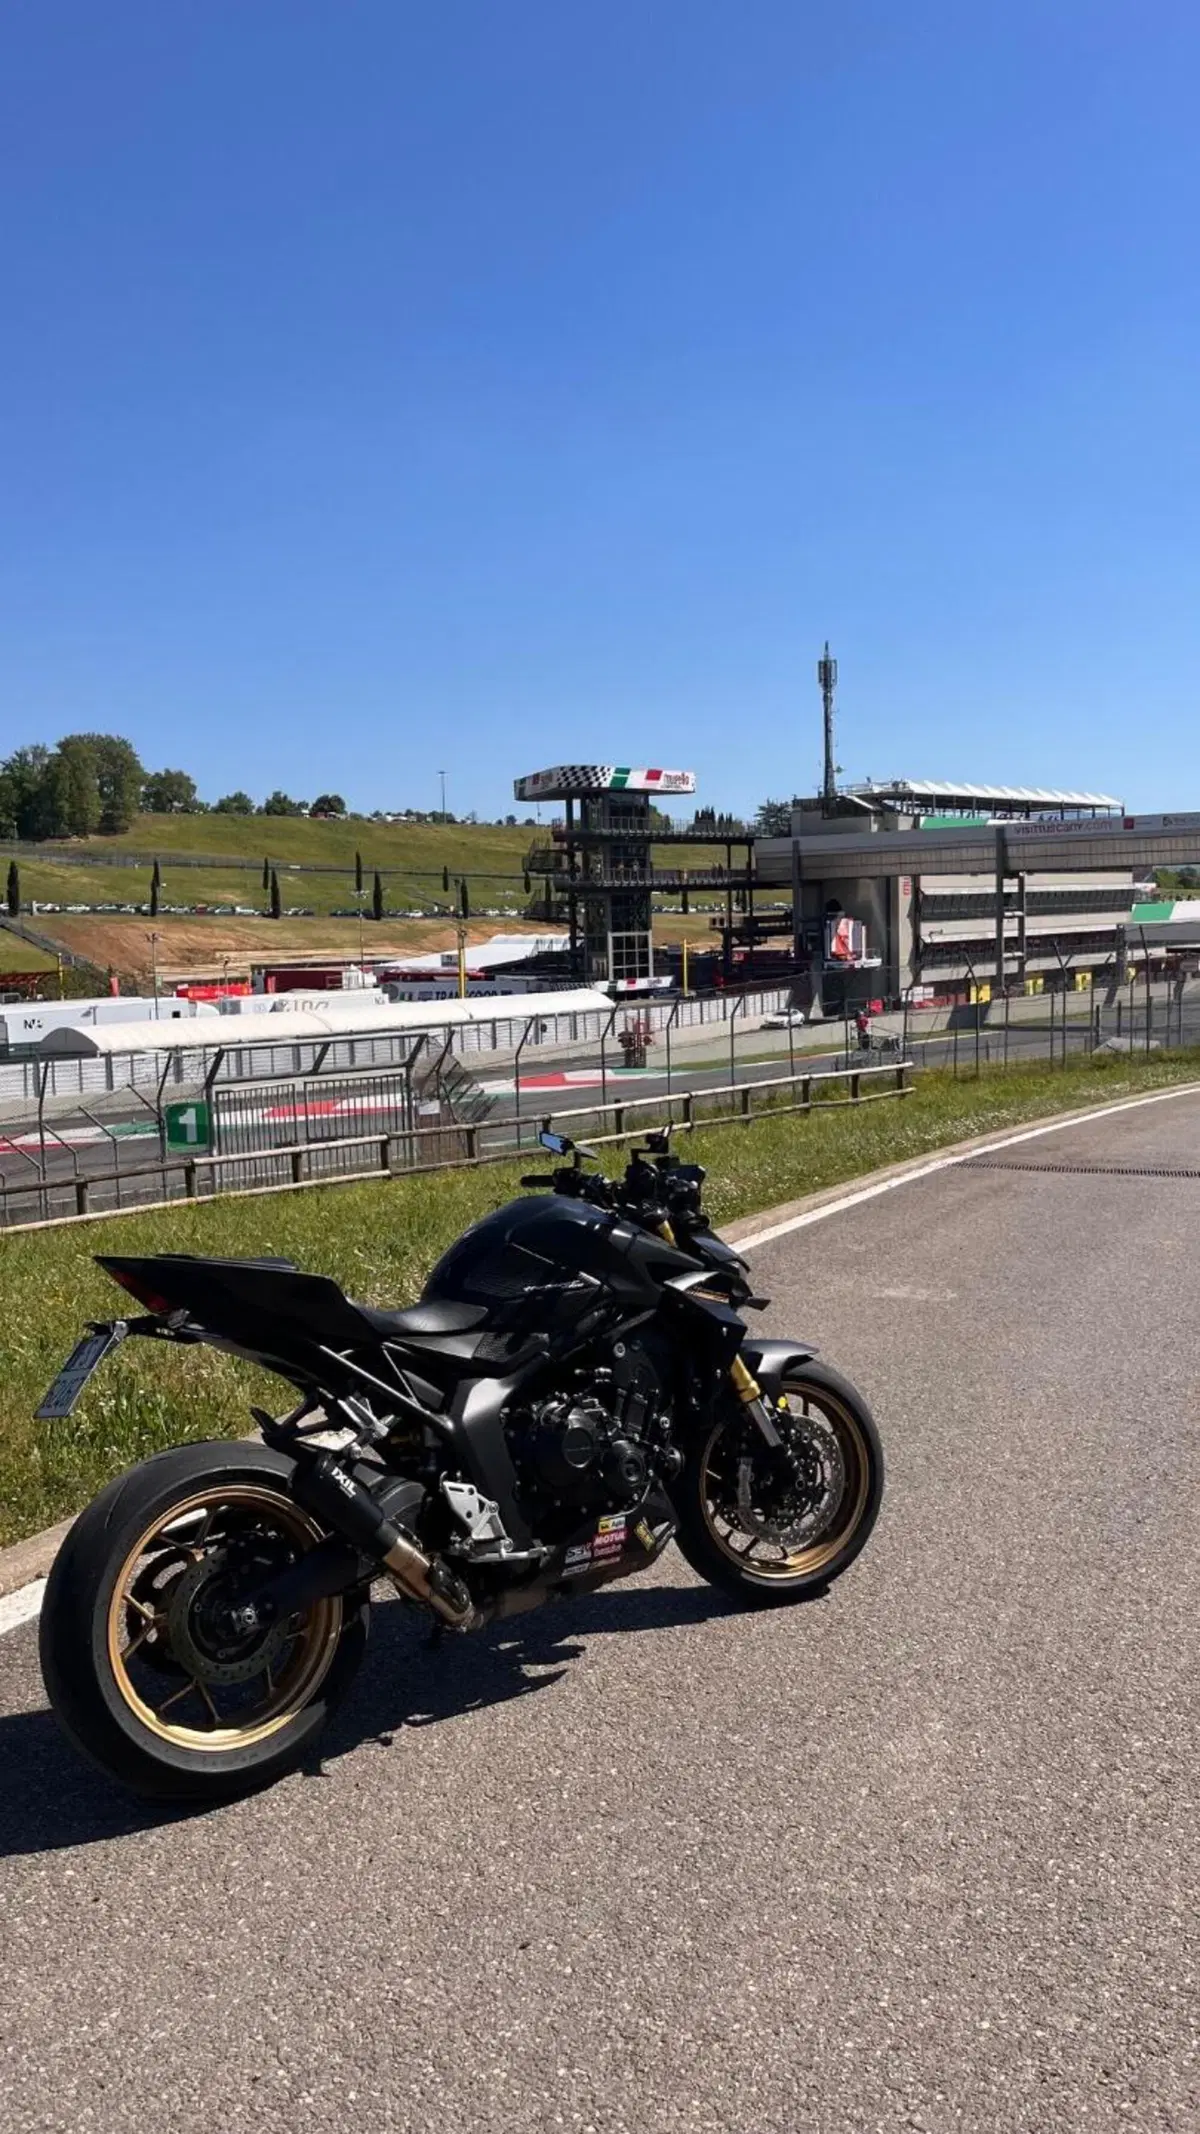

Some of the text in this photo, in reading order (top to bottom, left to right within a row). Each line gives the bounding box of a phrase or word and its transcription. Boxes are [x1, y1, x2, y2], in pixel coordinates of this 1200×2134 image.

[179, 1107, 197, 1143] 1
[331, 1466, 357, 1495] IXIL
[593, 1530, 626, 1546] MOTUL
